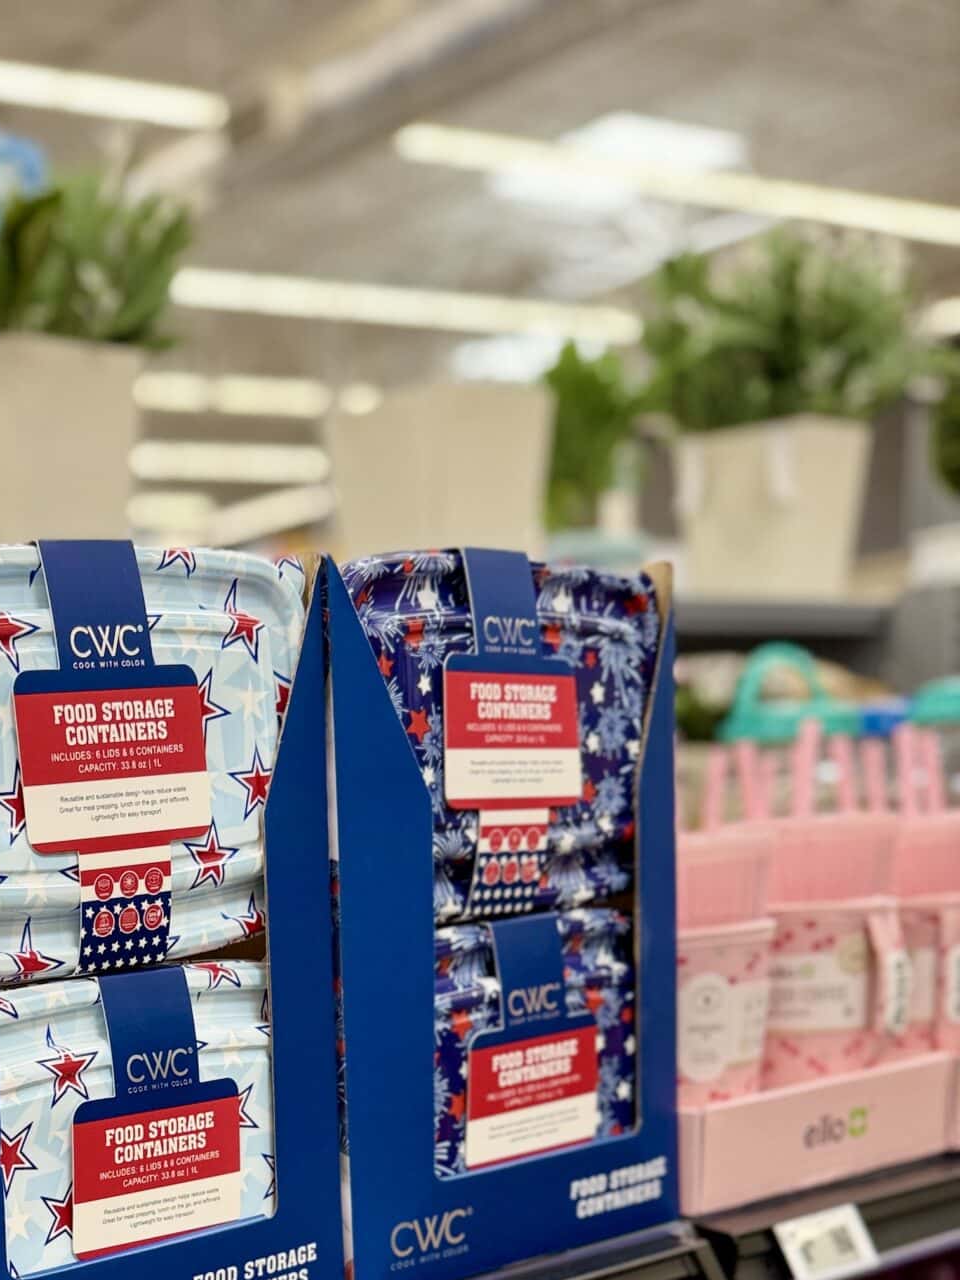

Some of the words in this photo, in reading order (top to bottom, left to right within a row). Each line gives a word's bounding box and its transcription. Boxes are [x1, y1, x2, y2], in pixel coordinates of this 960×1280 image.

[121, 659, 145, 667] COLOR
[470, 683, 501, 701] FOOD
[53, 703, 97, 725] FOOD
[102, 699, 175, 723] STORAGE
[65, 720, 168, 746] CONTAINERS
[102, 749, 120, 759] LIDS
[135, 744, 184, 756] CONTAINERS
[138, 760, 147, 769] oz
[105, 1125, 145, 1147] FOOD
[148, 1111, 215, 1138] STORAGE
[114, 1132, 207, 1165] CONTAINERS
[569, 1174, 607, 1201] FOOD
[610, 1156, 668, 1190] STORAGE
[576, 1179, 662, 1219] CONTAINERS
[243, 1242, 318, 1280] STORAGE
